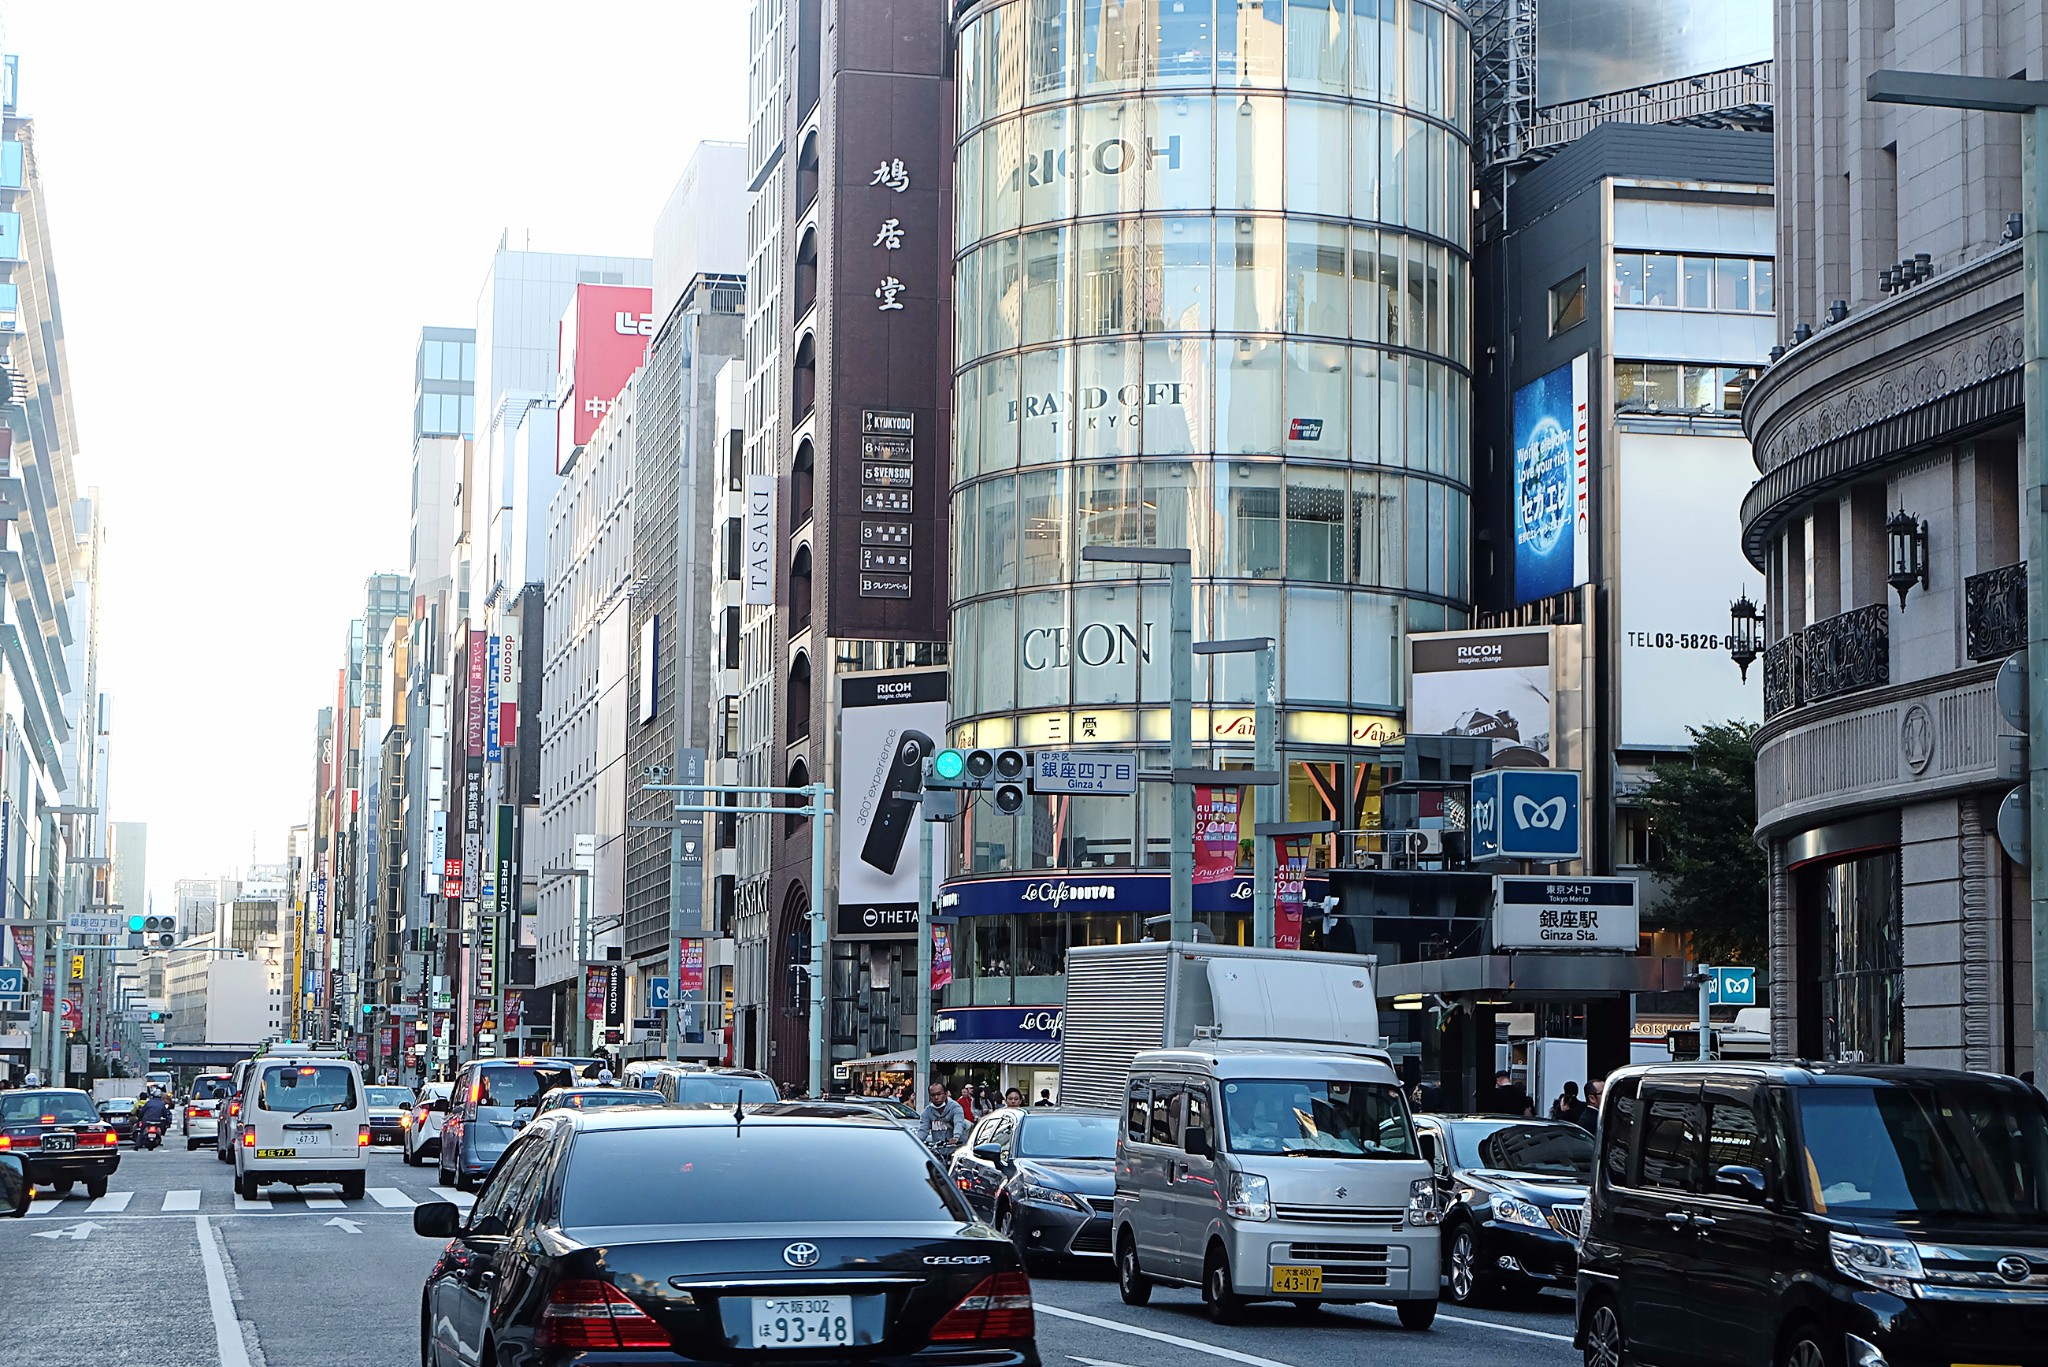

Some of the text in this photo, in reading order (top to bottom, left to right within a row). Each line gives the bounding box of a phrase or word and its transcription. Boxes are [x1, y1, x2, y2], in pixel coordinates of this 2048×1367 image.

[1012, 135, 1181, 192] RICOH
[870, 158, 910, 311] 鳩居堂
[874, 416, 911, 430] KYUKYODO
[865, 443, 873, 453] 6
[865, 466, 911, 479] 5 SVENSON
[1575, 403, 1587, 536] FUJITEC
[865, 495, 873, 505] 4
[864, 528, 873, 538] 3
[751, 491, 769, 591] TASAKI
[863, 581, 872, 590] B
[1628, 632, 1654, 647] TEL
[1457, 645, 1502, 656] RICOH
[505, 635, 515, 683] docomo
[1457, 655, 1503, 665] imagine. change.
[877, 682, 912, 694] RICOH
[877, 693, 895, 701] imagine.
[469, 685, 482, 747] NATARAJ
[1048, 717, 1097, 739] 三愛
[1468, 721, 1497, 737] PENTAX
[867, 727, 898, 798] experience.
[1041, 753, 1069, 761] 中央区
[1041, 761, 1130, 780] 銀座四丁目
[1068, 779, 1103, 789] Ginza 4
[1196, 822, 1236, 834] 2017
[1195, 865, 1233, 877] SHISEIDO
[1021, 881, 1115, 909] Le Café DOUTOR
[1546, 885, 1591, 895] 東京メトロ
[734, 876, 769, 920] TASAKI
[1549, 895, 1568, 904] Tokyo
[70, 918, 118, 928] 銀座四丁目
[879, 910, 919, 924] THETA
[1539, 909, 1599, 928] 銀座駅
[1540, 929, 1598, 941] Ginza Sta.
[1019, 1012, 1036, 1030] Le
[299, 1135, 319, 1143] 67-31
[258, 1149, 295, 1157] 高圧ガス
[923, 1255, 991, 1265] CELSIOR
[1284, 1277, 1319, 1291] 43-17
[759, 1315, 847, 1343] ほ 93-48
